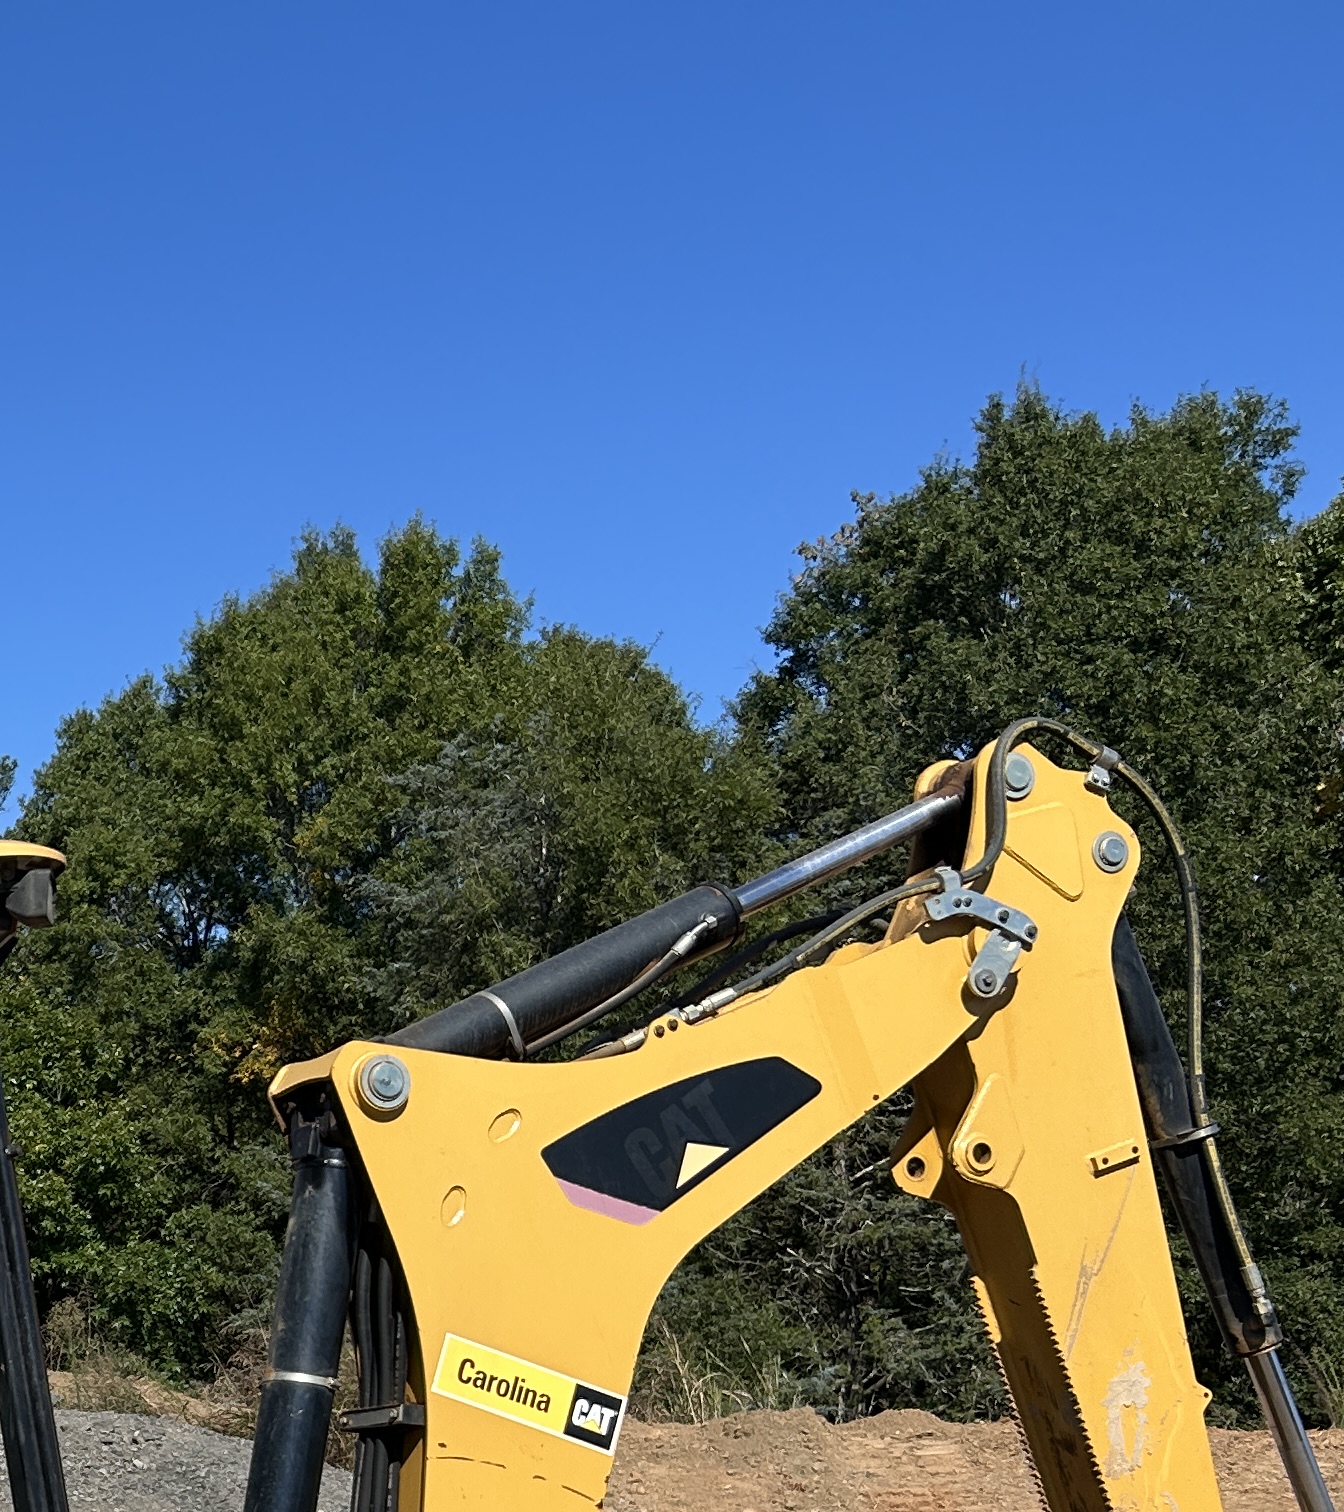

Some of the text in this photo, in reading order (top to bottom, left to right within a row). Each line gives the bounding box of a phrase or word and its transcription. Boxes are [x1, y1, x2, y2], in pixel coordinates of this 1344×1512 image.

[624, 1079, 737, 1198] CAT
[457, 1358, 616, 1437] Carolina CAT
